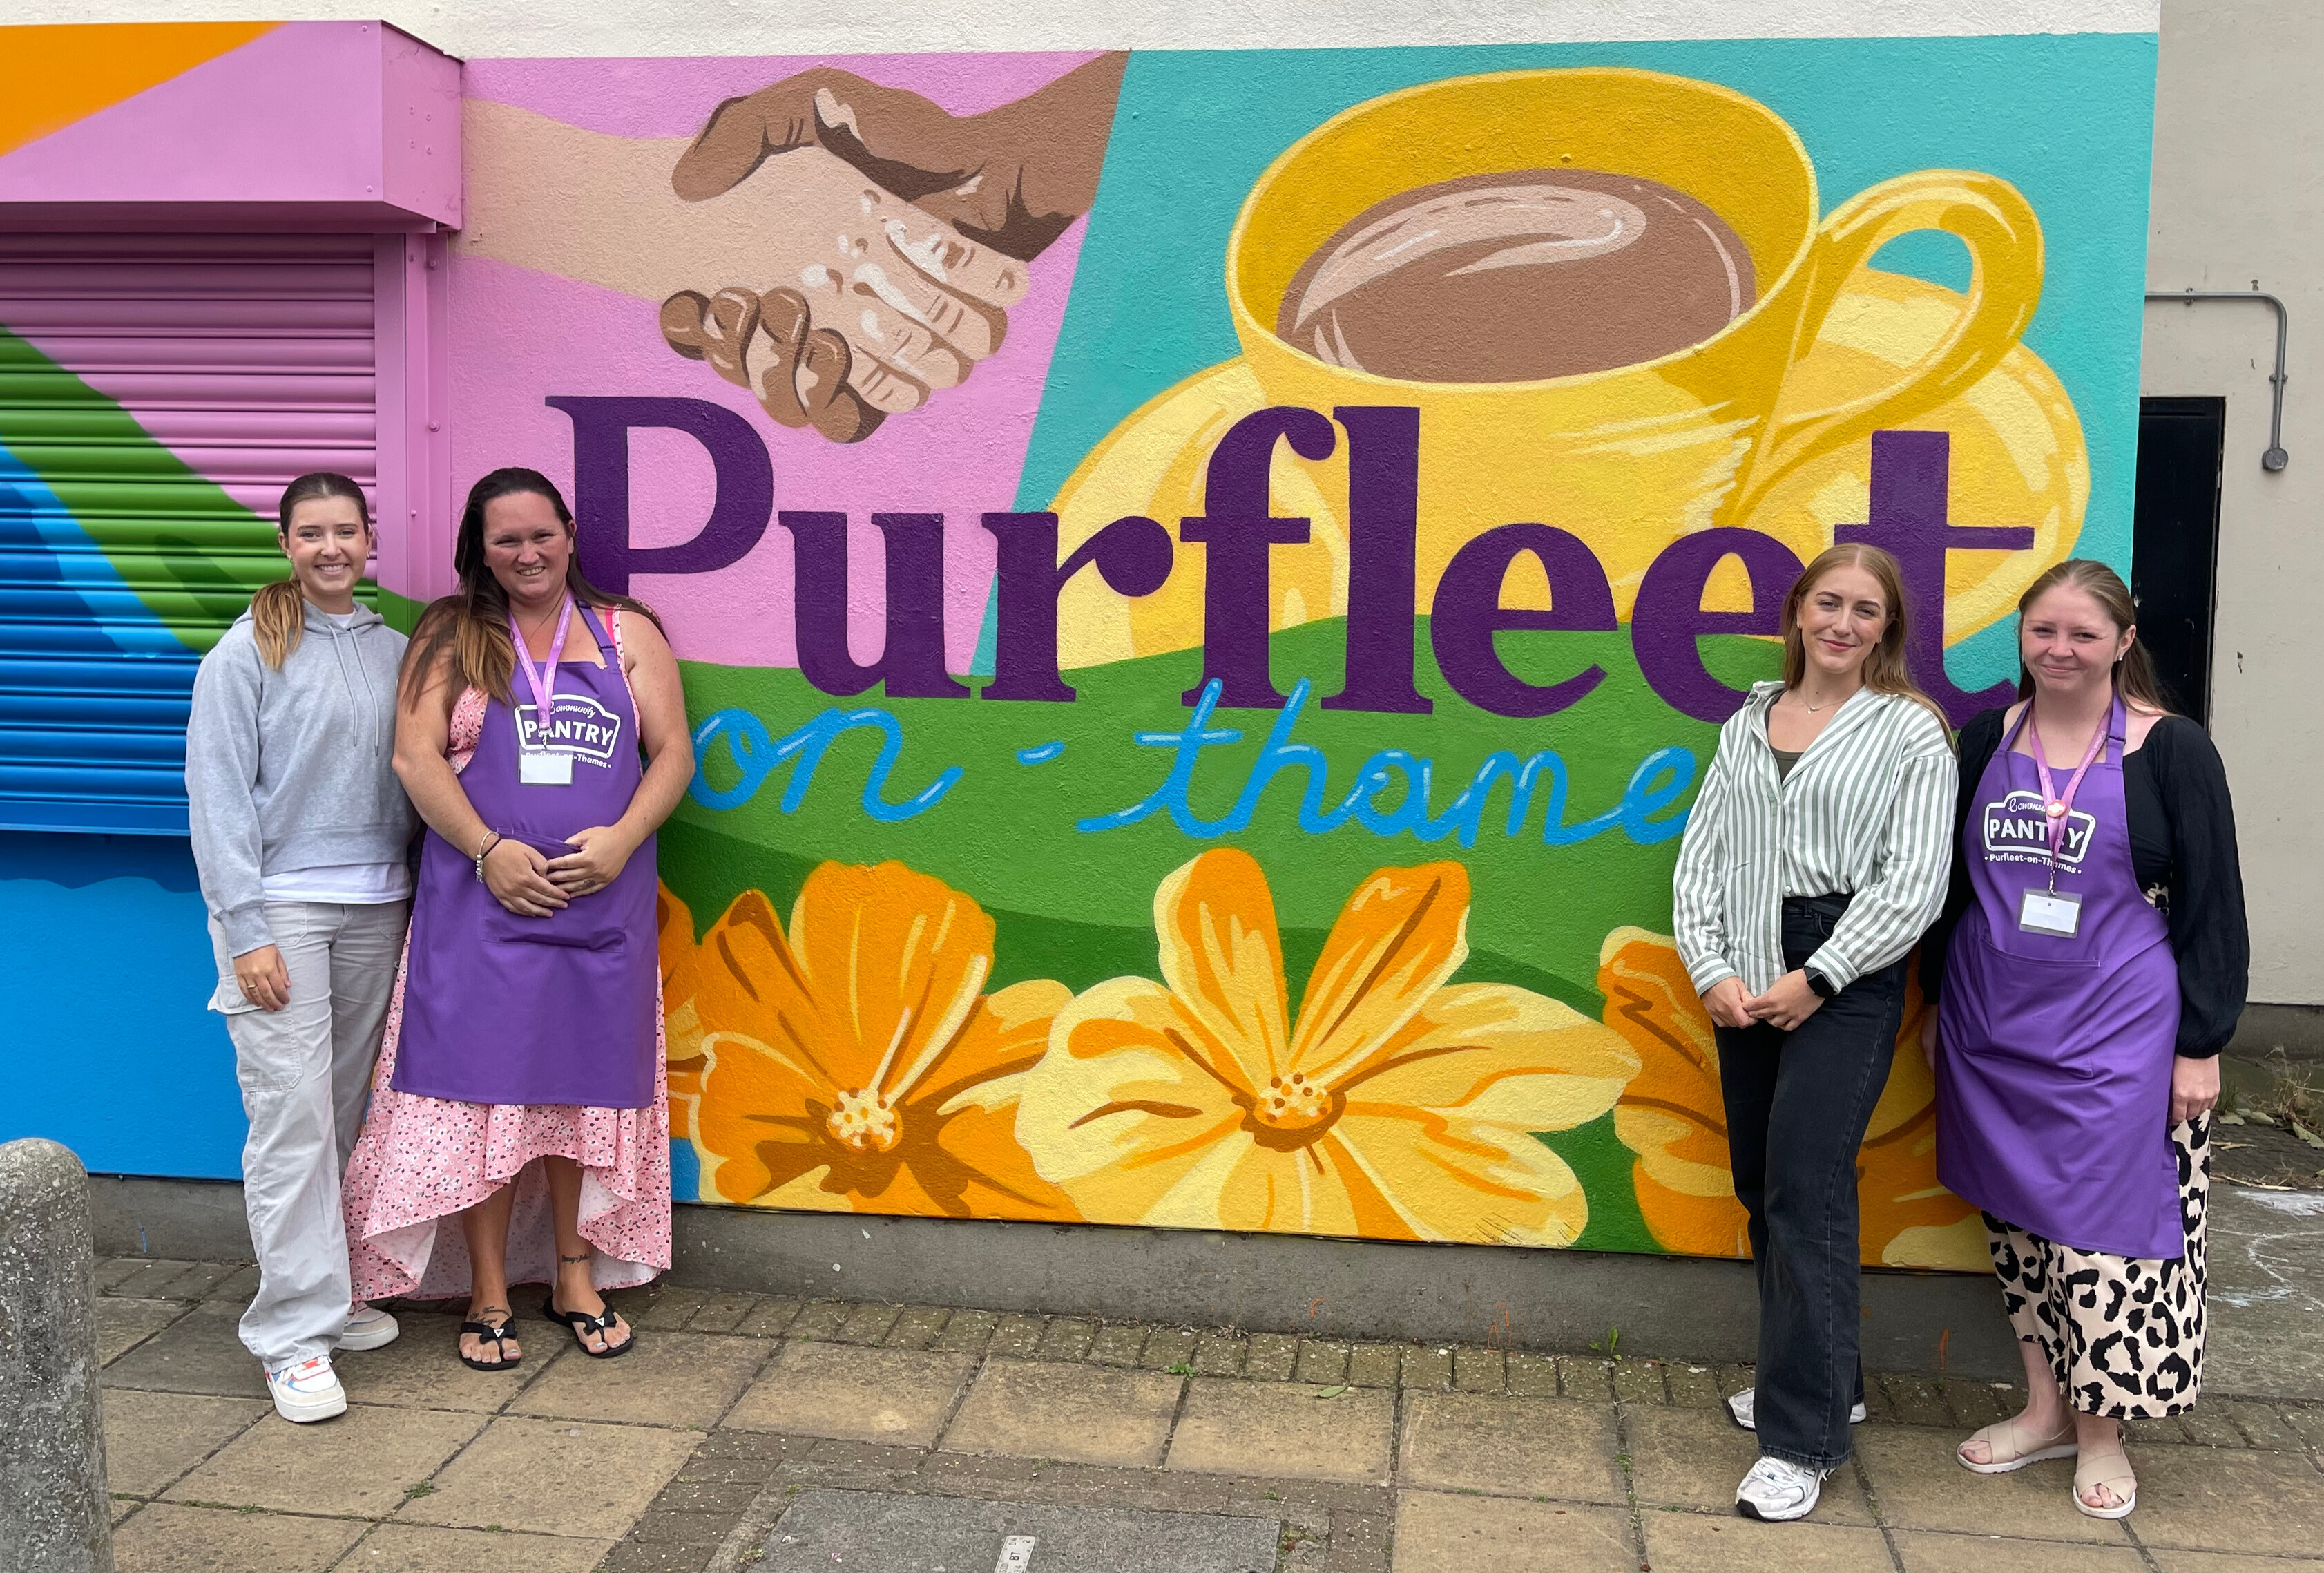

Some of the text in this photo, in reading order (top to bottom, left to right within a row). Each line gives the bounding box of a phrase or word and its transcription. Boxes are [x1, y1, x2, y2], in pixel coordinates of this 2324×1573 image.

[546, 394, 2035, 730] Purfleet
[689, 707, 963, 822] on
[1075, 677, 1698, 848] thame
[1990, 818, 2084, 849] PANTY
[1009, 1551, 1021, 1561] BT
